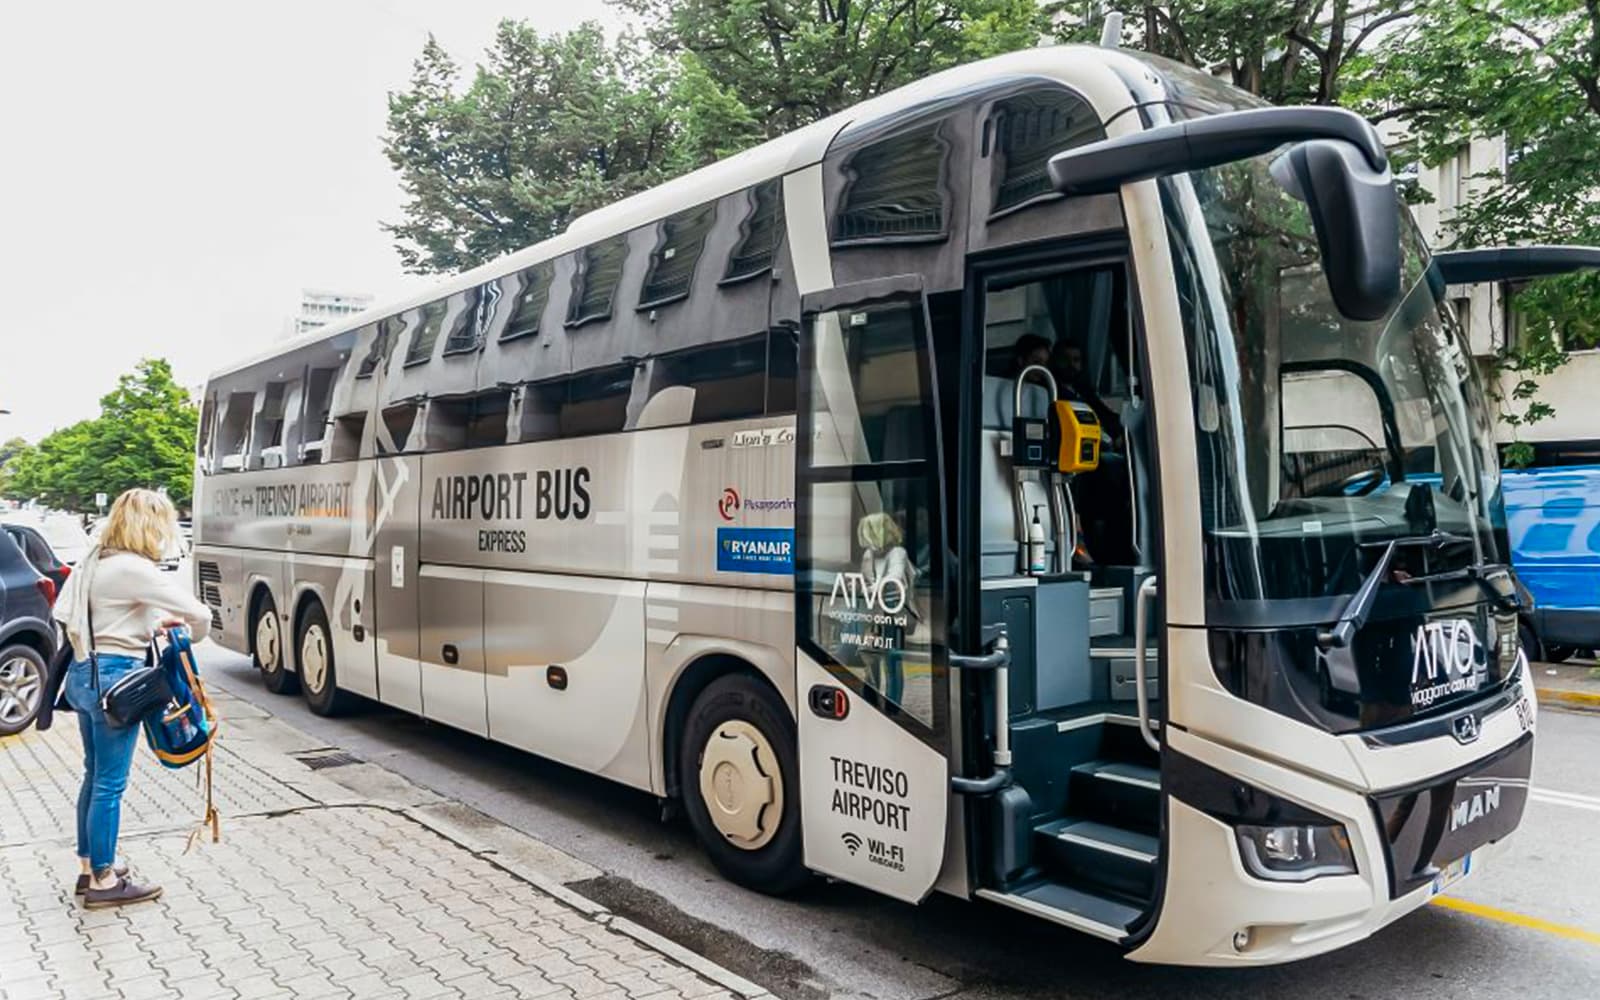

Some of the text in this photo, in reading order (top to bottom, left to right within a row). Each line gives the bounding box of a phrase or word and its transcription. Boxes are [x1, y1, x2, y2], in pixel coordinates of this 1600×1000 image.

[255, 484, 297, 518] TREVISO
[299, 482, 351, 518] AIRPORT
[431, 466, 591, 521] AIRPORT BUS
[478, 529, 527, 553] EXPRESS
[731, 540, 791, 555] RYANAIR
[829, 572, 906, 614] ATVO
[873, 614, 892, 625] con
[894, 614, 908, 627] voi
[1411, 618, 1475, 684] ATVO
[829, 756, 909, 799] TREVISO
[831, 788, 911, 832] AIRPORT
[1450, 784, 1501, 832] MAN
